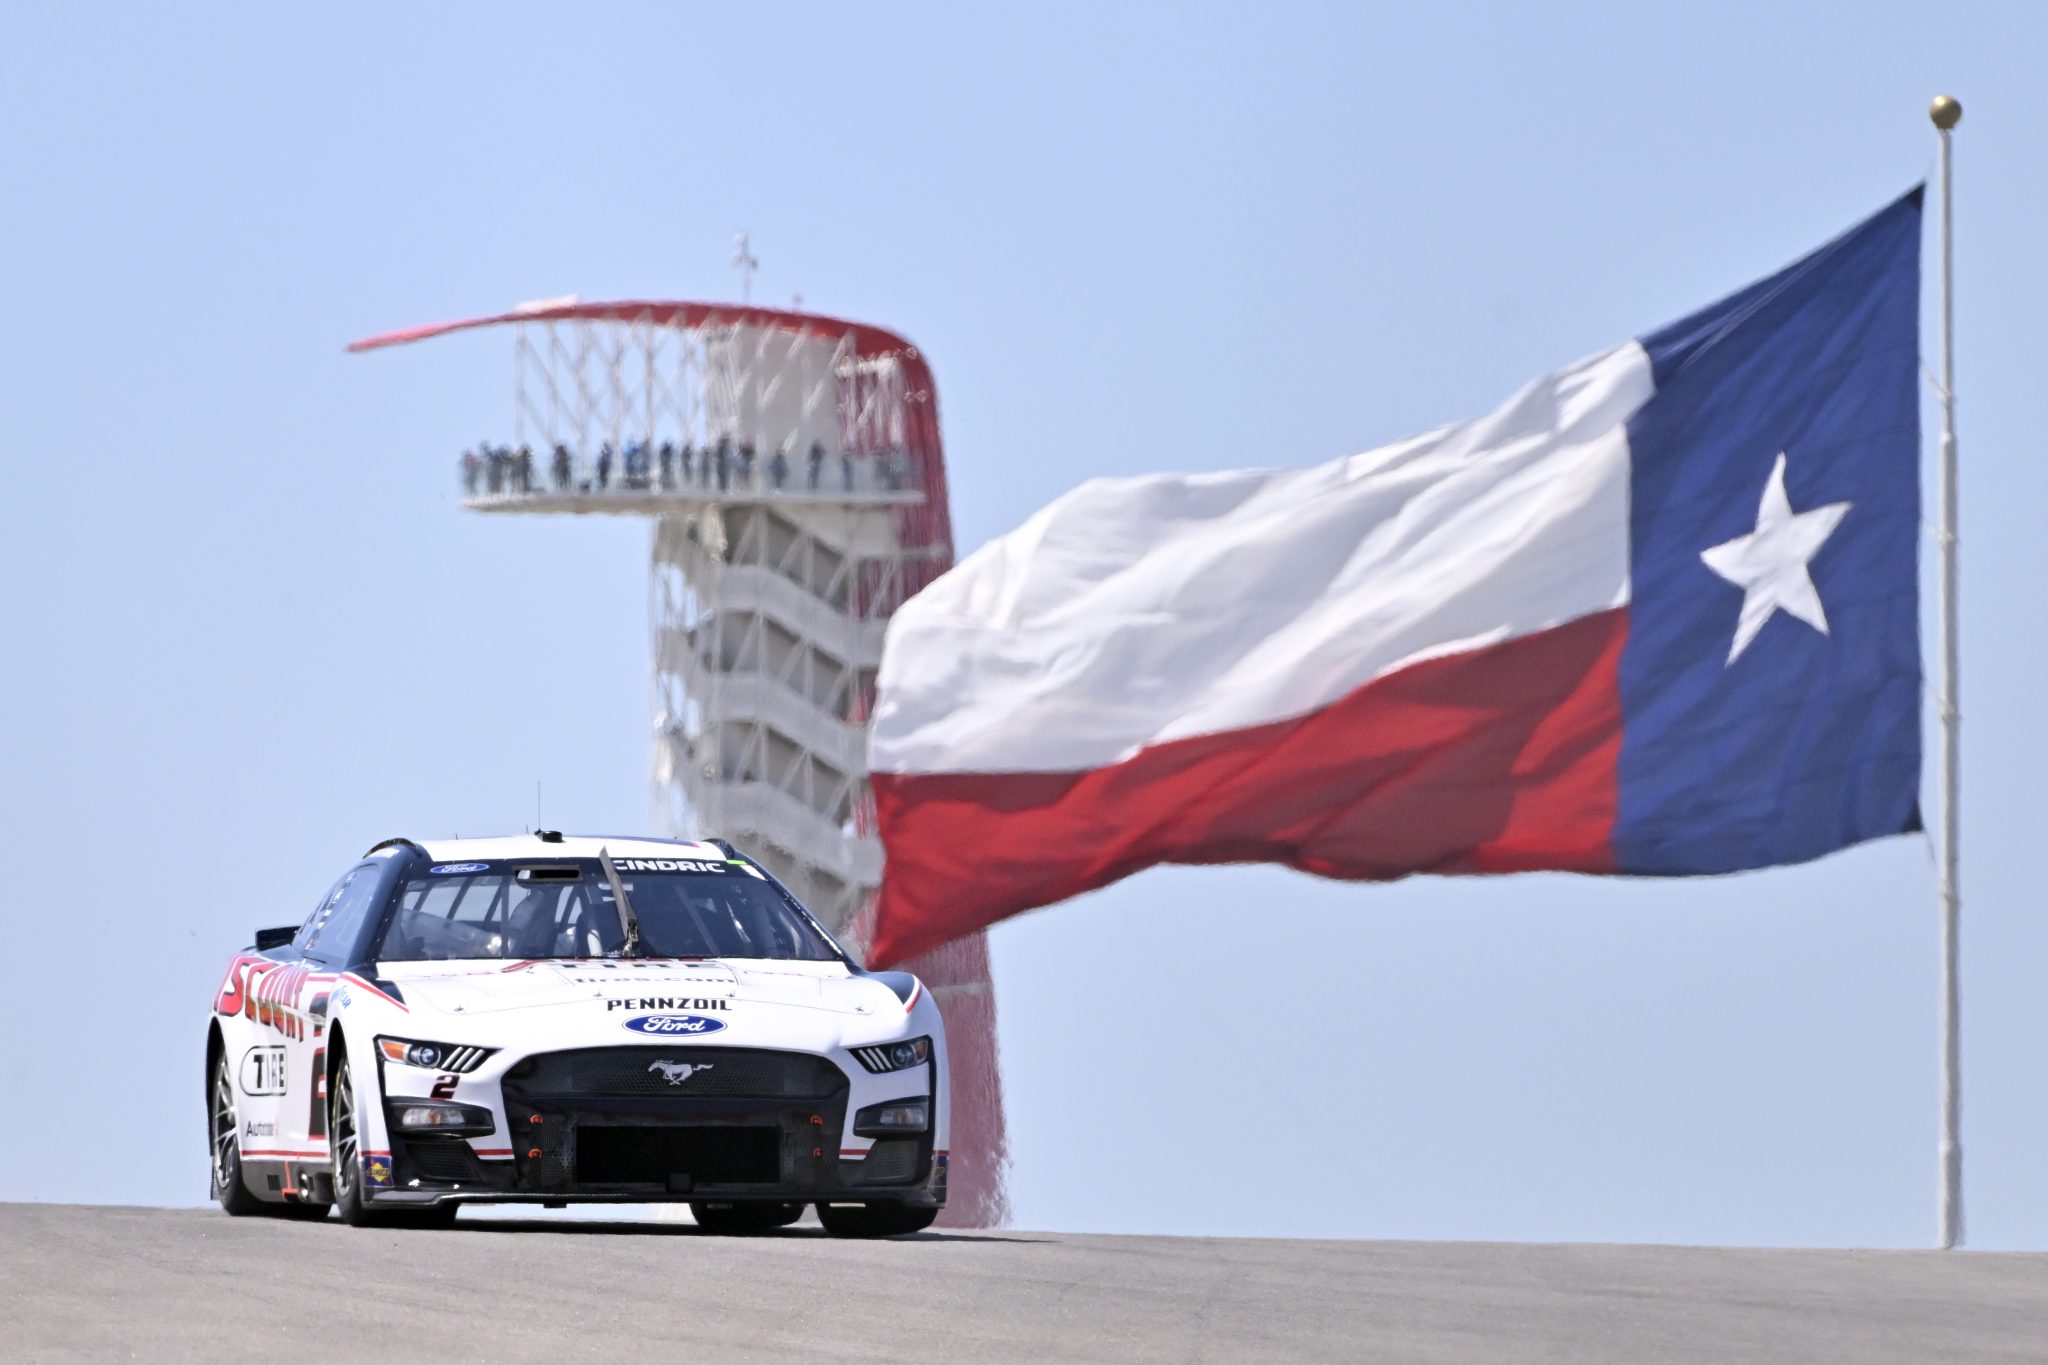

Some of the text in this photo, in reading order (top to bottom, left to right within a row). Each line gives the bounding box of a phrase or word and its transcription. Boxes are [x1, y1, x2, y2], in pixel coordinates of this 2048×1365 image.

[441, 863, 478, 873] Ford
[612, 859, 726, 873] CINDRIC
[607, 998, 732, 1012] PENNZOIL
[643, 1015, 706, 1033] Ford
[253, 1053, 285, 1089] TIRE
[430, 1073, 461, 1100] 2
